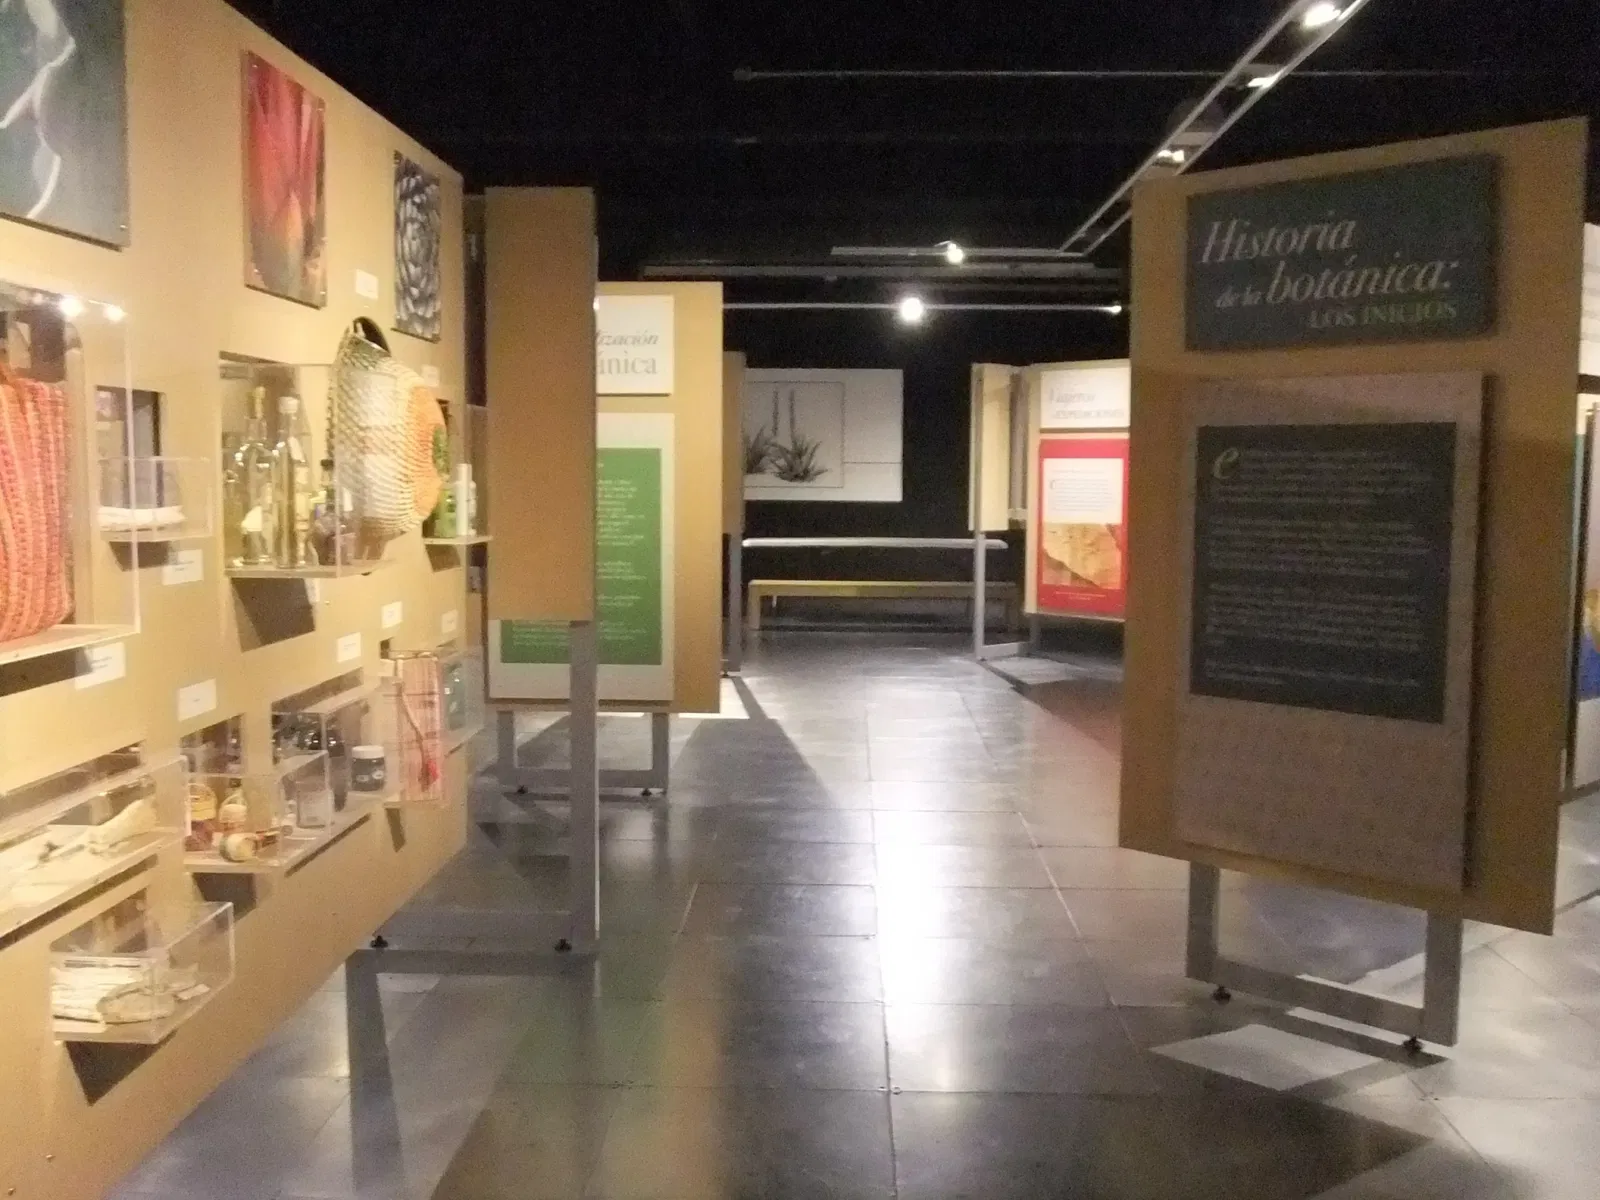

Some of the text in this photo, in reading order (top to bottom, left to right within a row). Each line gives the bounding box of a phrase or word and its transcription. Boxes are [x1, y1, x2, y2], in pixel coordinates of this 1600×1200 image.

[1199, 210, 1356, 263] Historia
[1265, 252, 1458, 305] botánica:
[1309, 309, 1355, 328] LOS
